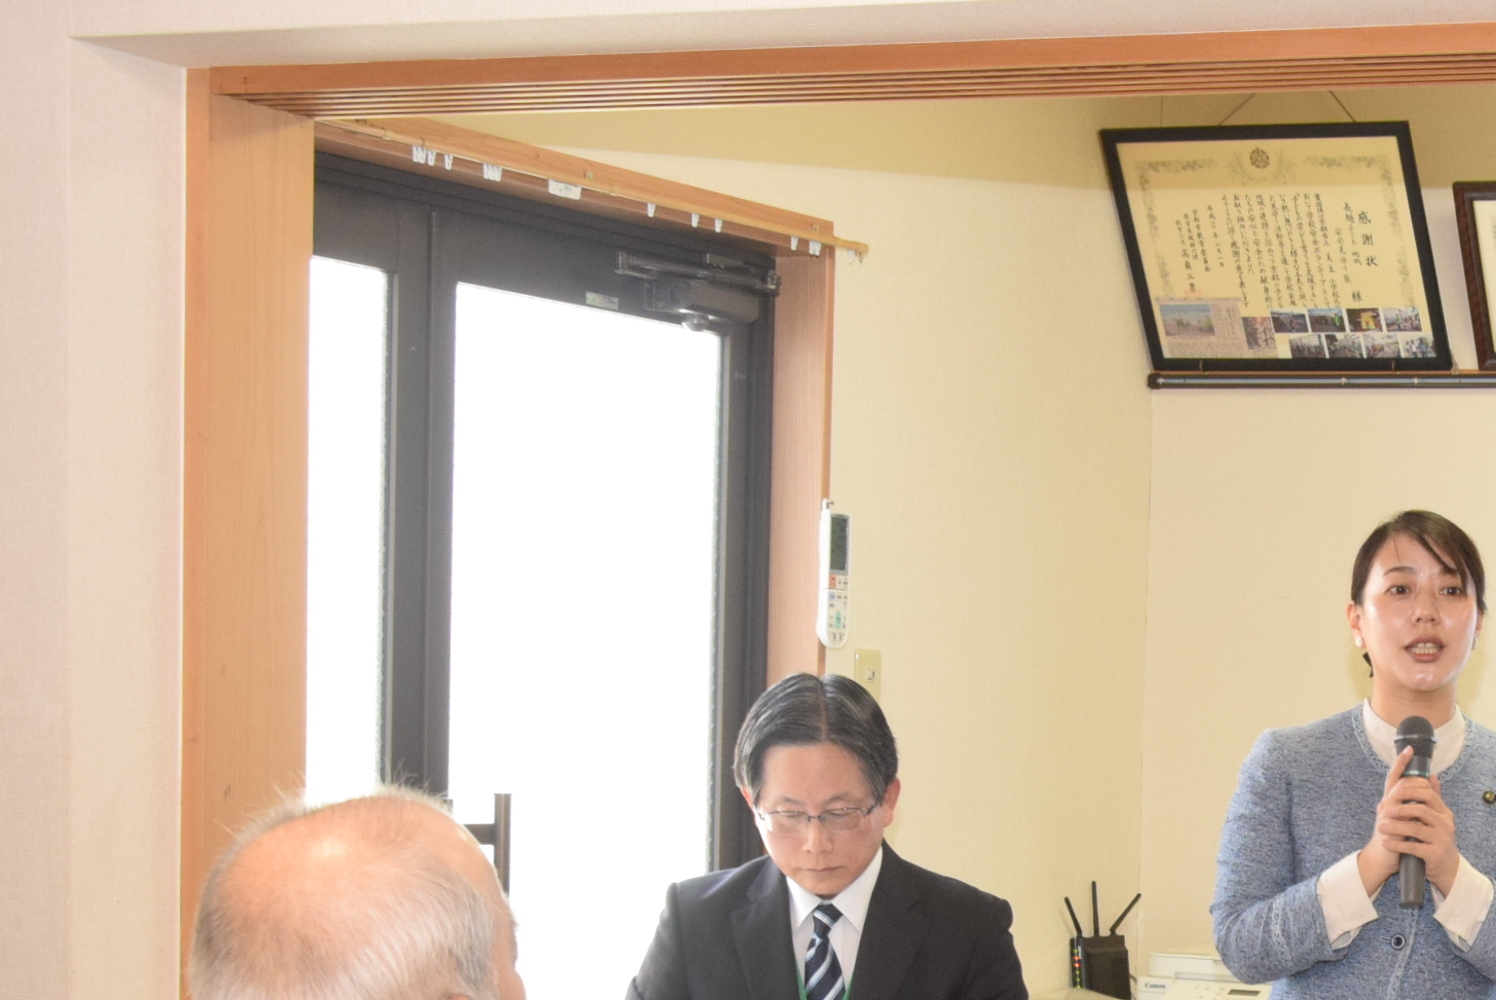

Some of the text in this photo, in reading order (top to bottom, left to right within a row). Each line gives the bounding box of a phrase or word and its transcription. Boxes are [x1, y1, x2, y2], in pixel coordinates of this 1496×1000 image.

[1358, 210, 1378, 267] 感謝状
[1351, 290, 1363, 302] 様
